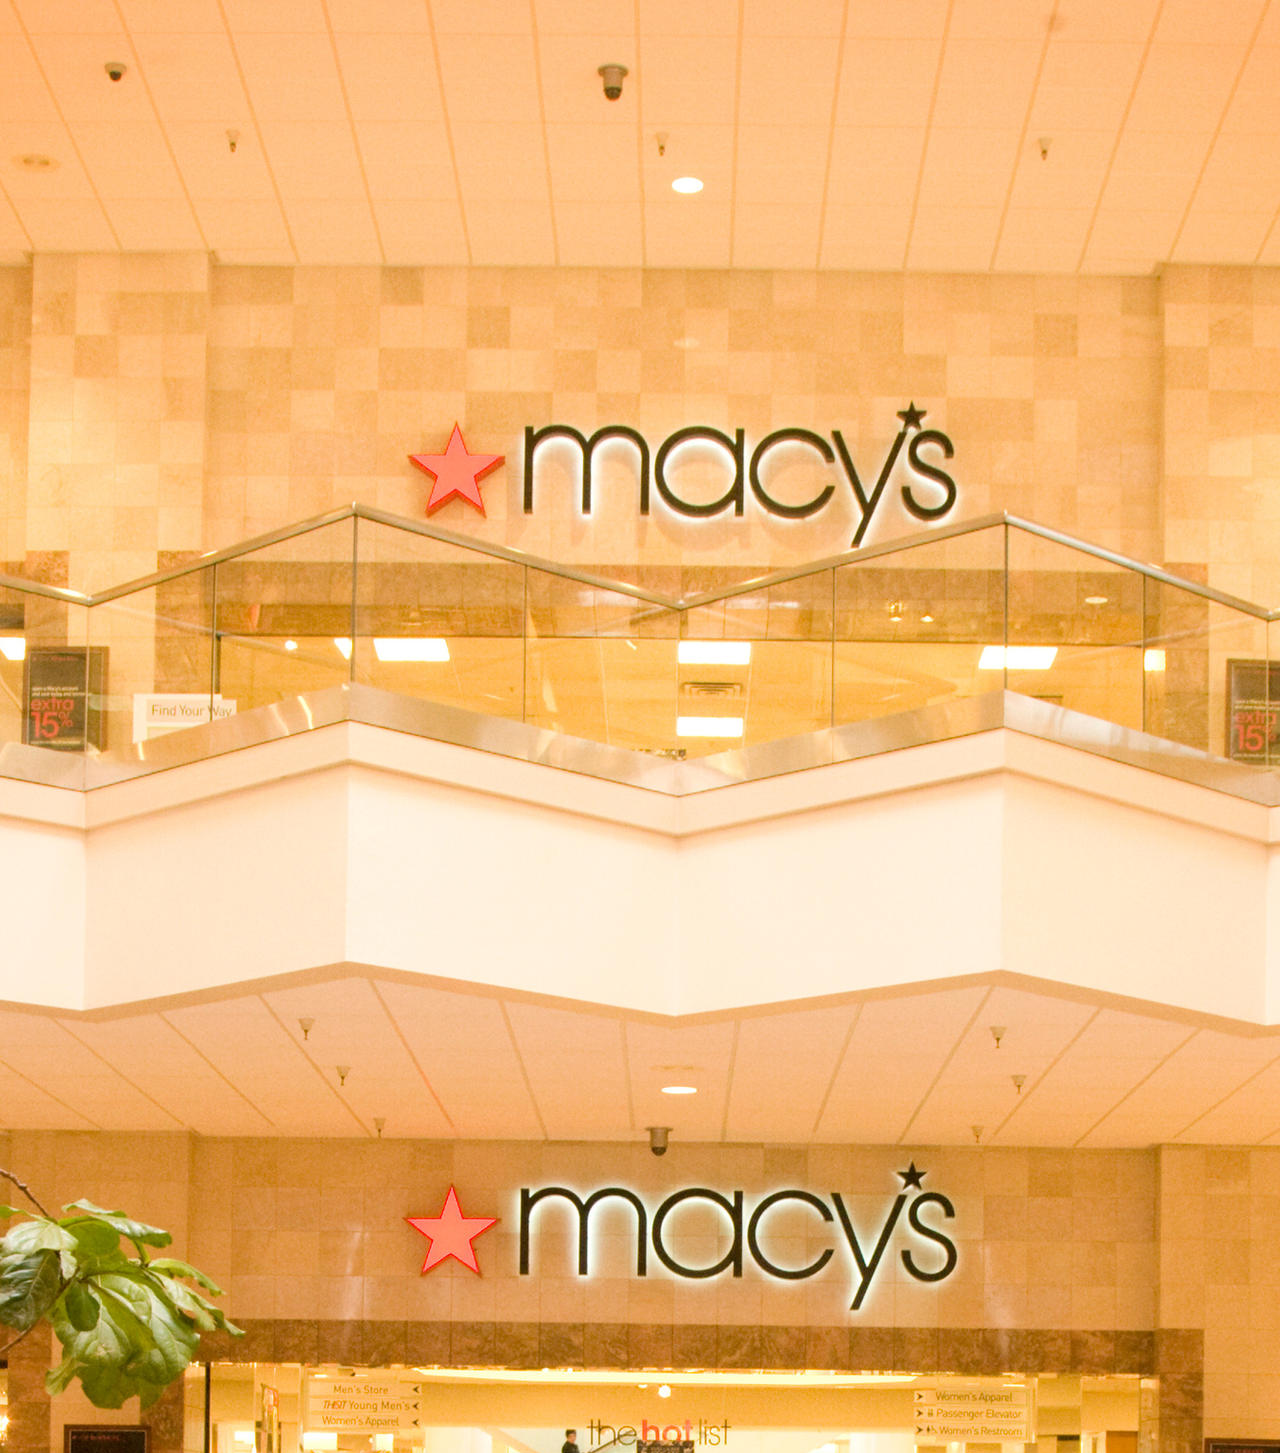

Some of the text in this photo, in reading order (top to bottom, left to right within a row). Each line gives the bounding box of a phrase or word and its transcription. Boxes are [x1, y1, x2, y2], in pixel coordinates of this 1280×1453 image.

[524, 401, 957, 547] macy's
[31, 697, 74, 711] extra
[152, 704, 232, 719] Find Your Way
[1235, 710, 1277, 724] extra
[31, 712, 74, 738] 15%
[520, 1161, 958, 1310] macy's
[333, 1385, 389, 1395] Men's Store
[935, 1391, 1013, 1403] Women's Apparel
[348, 1400, 378, 1411] Young
[381, 1400, 410, 1410] Men's
[322, 1415, 400, 1427] Women's Apparel
[936, 1408, 1022, 1420] Passenger Elevator
[586, 1418, 732, 1446] the hot list
[939, 1425, 1023, 1436] Women's Restroom
